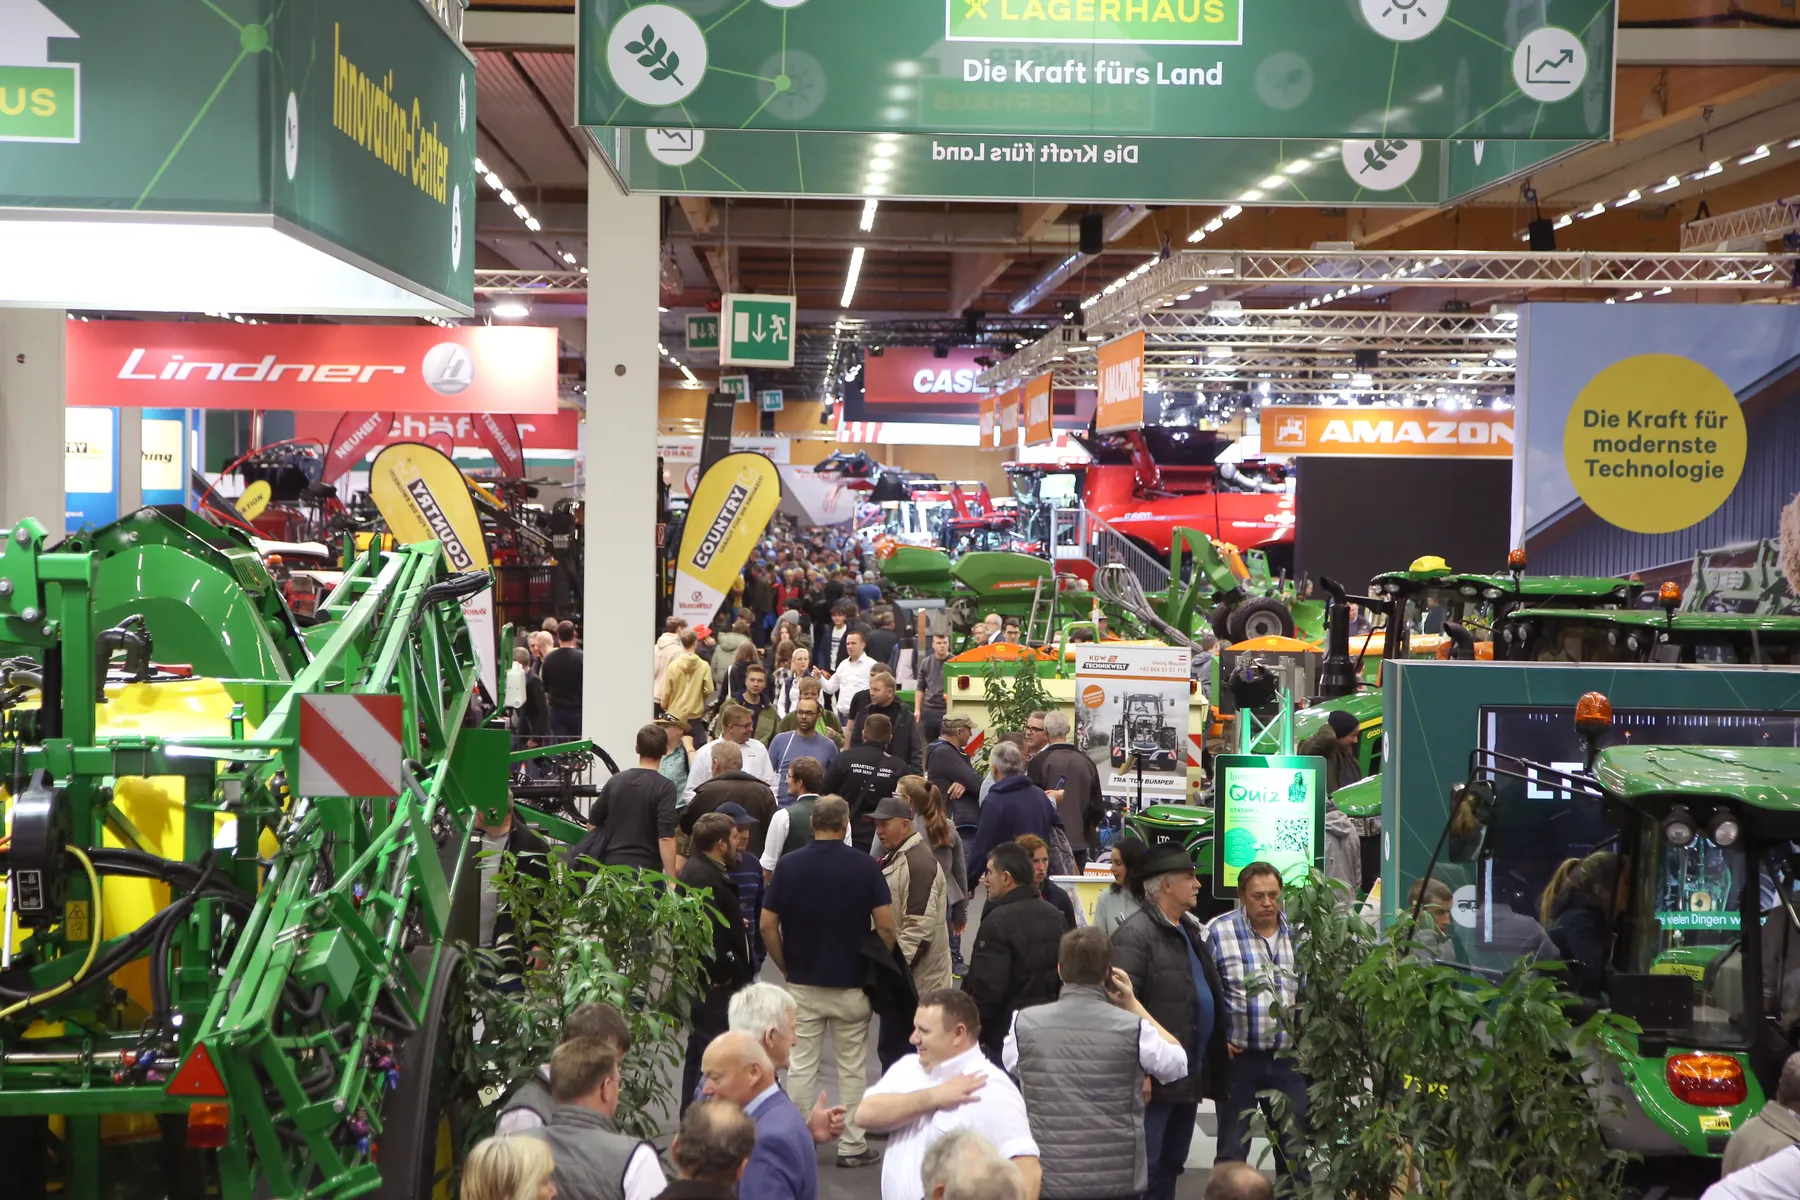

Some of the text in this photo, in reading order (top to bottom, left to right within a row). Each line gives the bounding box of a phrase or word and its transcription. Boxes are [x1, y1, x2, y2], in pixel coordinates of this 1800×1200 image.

[1000, 0, 1225, 23] LAGERHAUS
[963, 58, 1223, 86] Die Kraft fürs Land
[333, 21, 449, 205] Innovation-Center
[117, 348, 406, 383] Lindner
[1583, 409, 1728, 429] Die Kraft für
[335, 412, 383, 460] NEUHEIT
[1593, 434, 1717, 454] modernste
[1584, 458, 1724, 483] Technologie
[696, 486, 744, 566] COUNTRY
[1085, 662, 1128, 670] TECHNIKWELT
[1144, 778, 1175, 786] BUMPER
[1229, 784, 1281, 804] Quiz
[1667, 914, 1690, 926] vielen
[1691, 914, 1727, 927] Dingen
